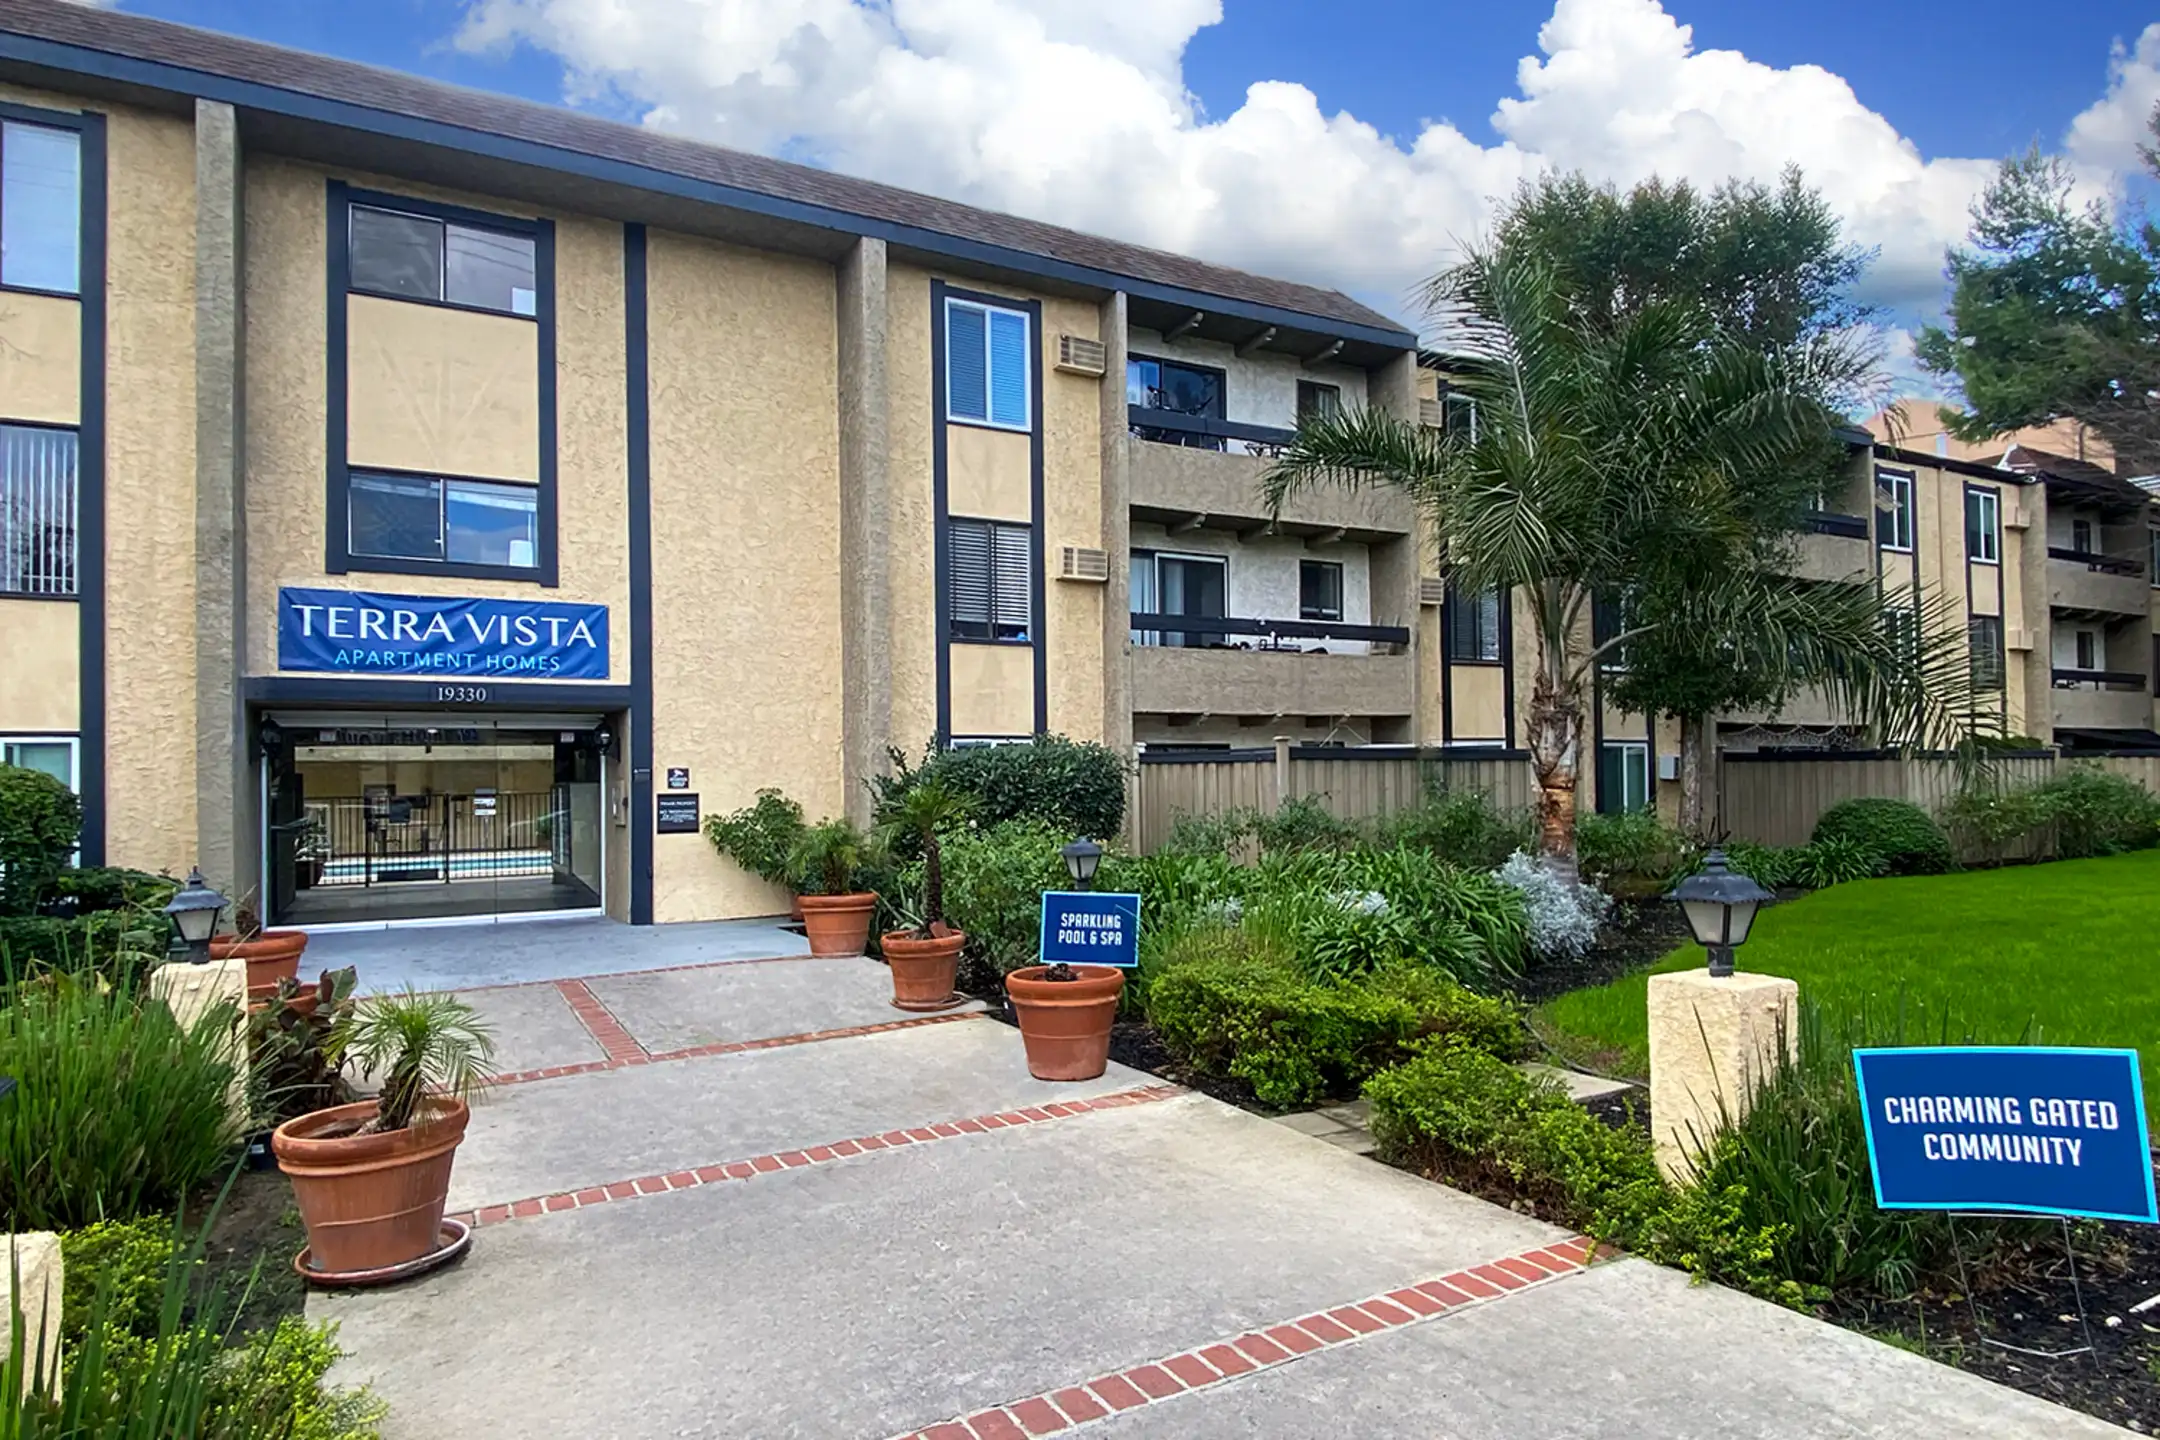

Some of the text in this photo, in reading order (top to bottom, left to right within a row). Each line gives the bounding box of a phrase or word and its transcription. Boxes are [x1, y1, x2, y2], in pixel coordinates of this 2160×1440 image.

[291, 604, 597, 648] TERRA VISTA
[334, 649, 560, 671] APARTMENT HOMES
[438, 687, 487, 701] 19330
[1061, 913, 1121, 929] SPARKLING
[1058, 930, 1123, 946] POOL & SPA
[1884, 1096, 2119, 1130] CHARMING GATED
[1923, 1133, 2082, 1167] COMMUNITY
